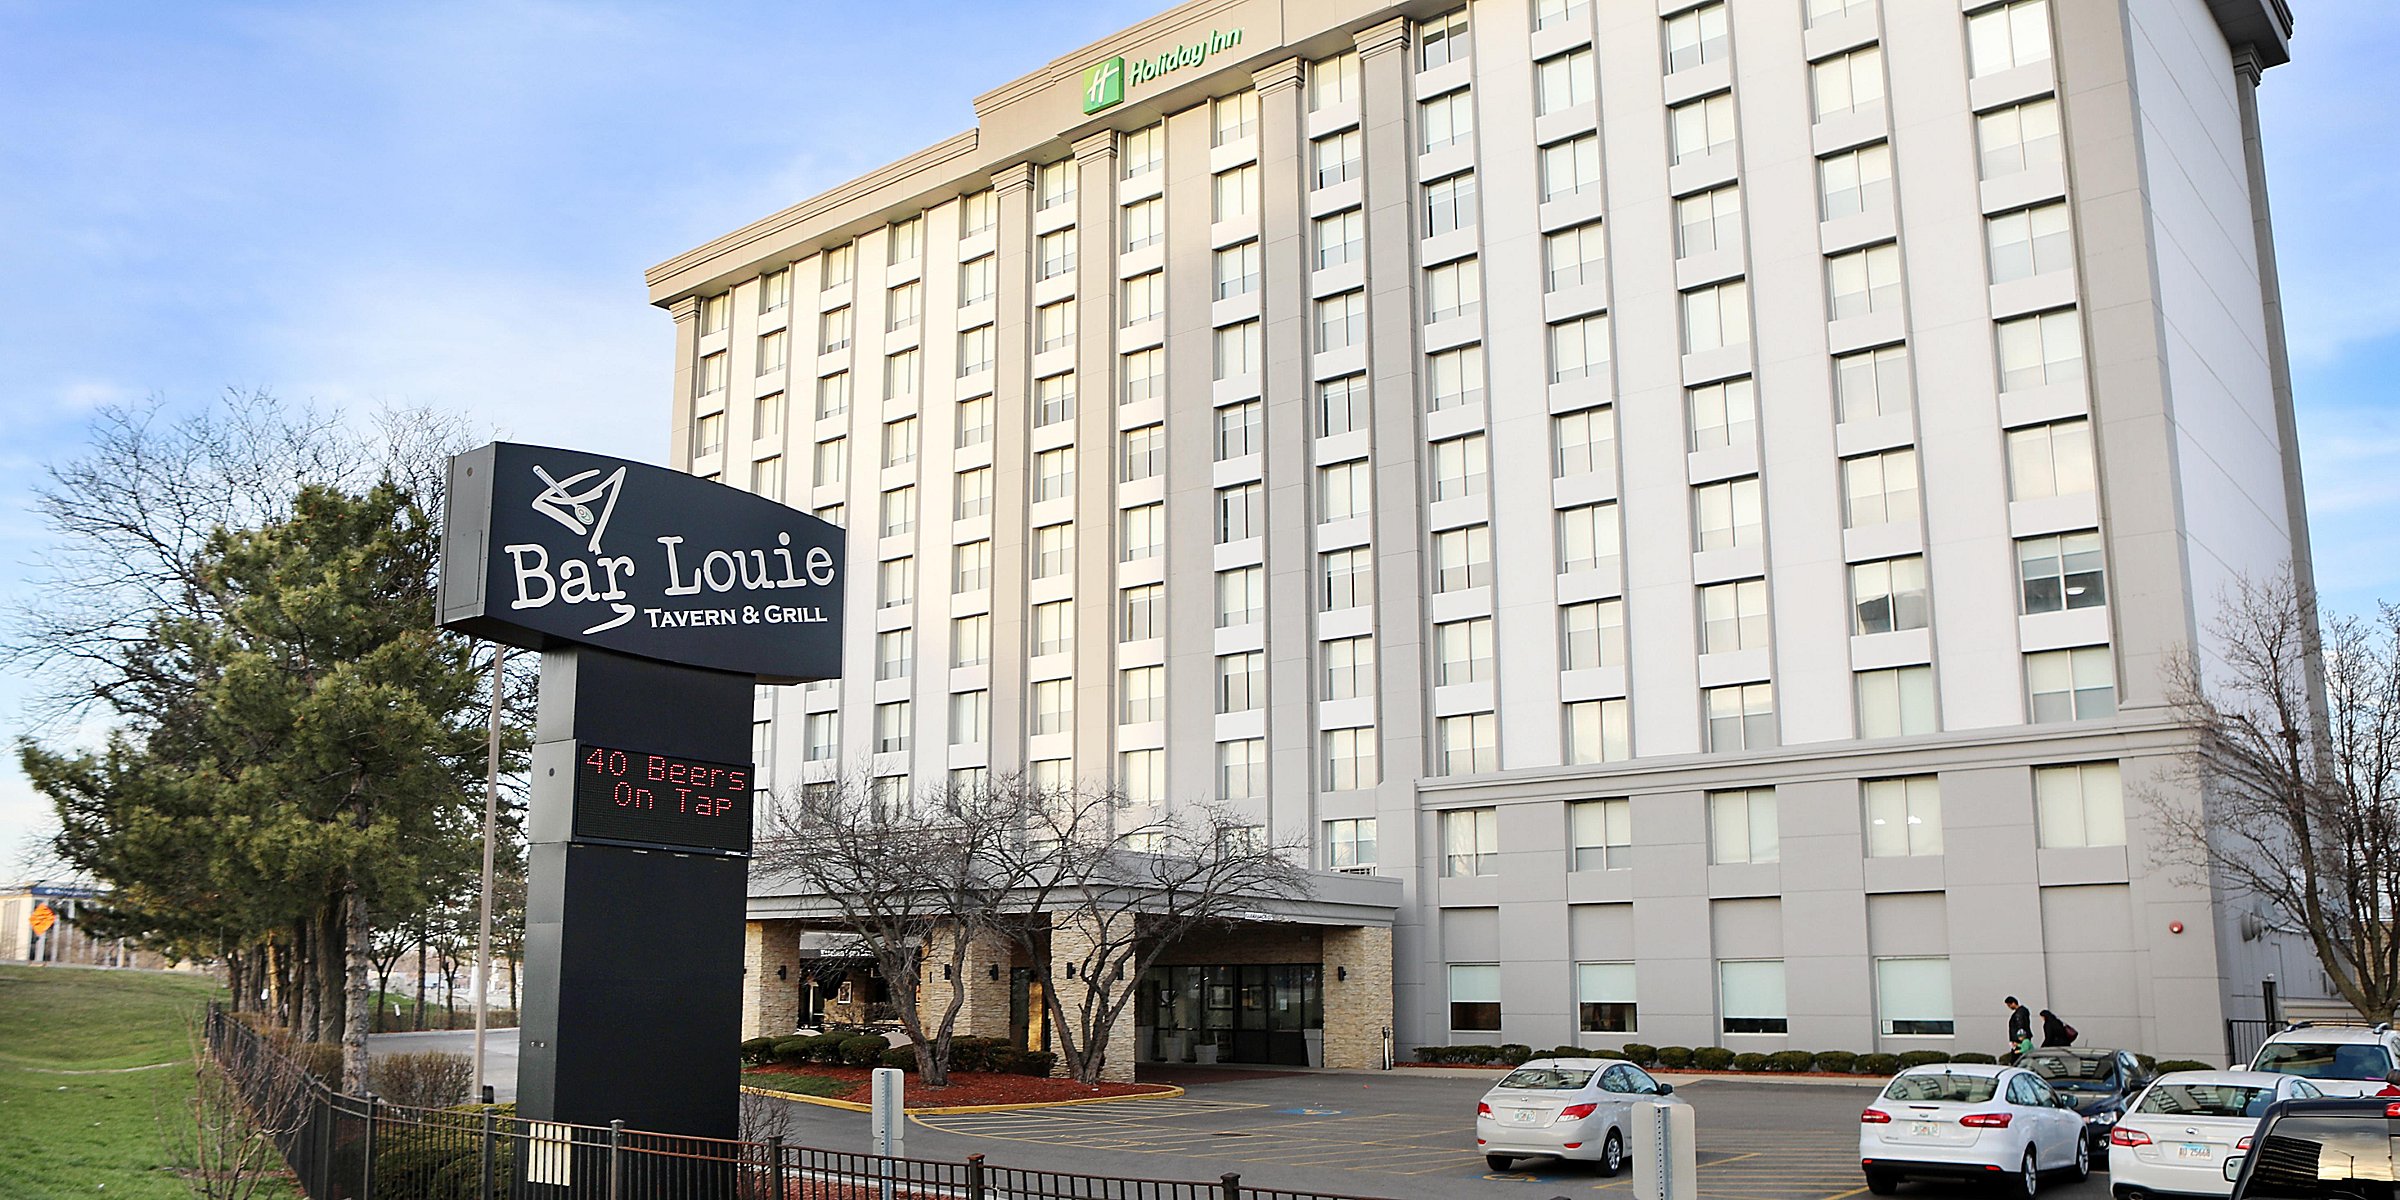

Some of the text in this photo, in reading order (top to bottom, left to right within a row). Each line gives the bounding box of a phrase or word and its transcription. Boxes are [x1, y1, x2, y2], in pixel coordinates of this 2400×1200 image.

[1129, 27, 1242, 87] Holiday Inn
[503, 531, 835, 611] Bar Louie
[643, 604, 828, 629] TAVERN & GRILL
[586, 748, 745, 791] 40 Beers
[614, 781, 733, 817] On Tap
